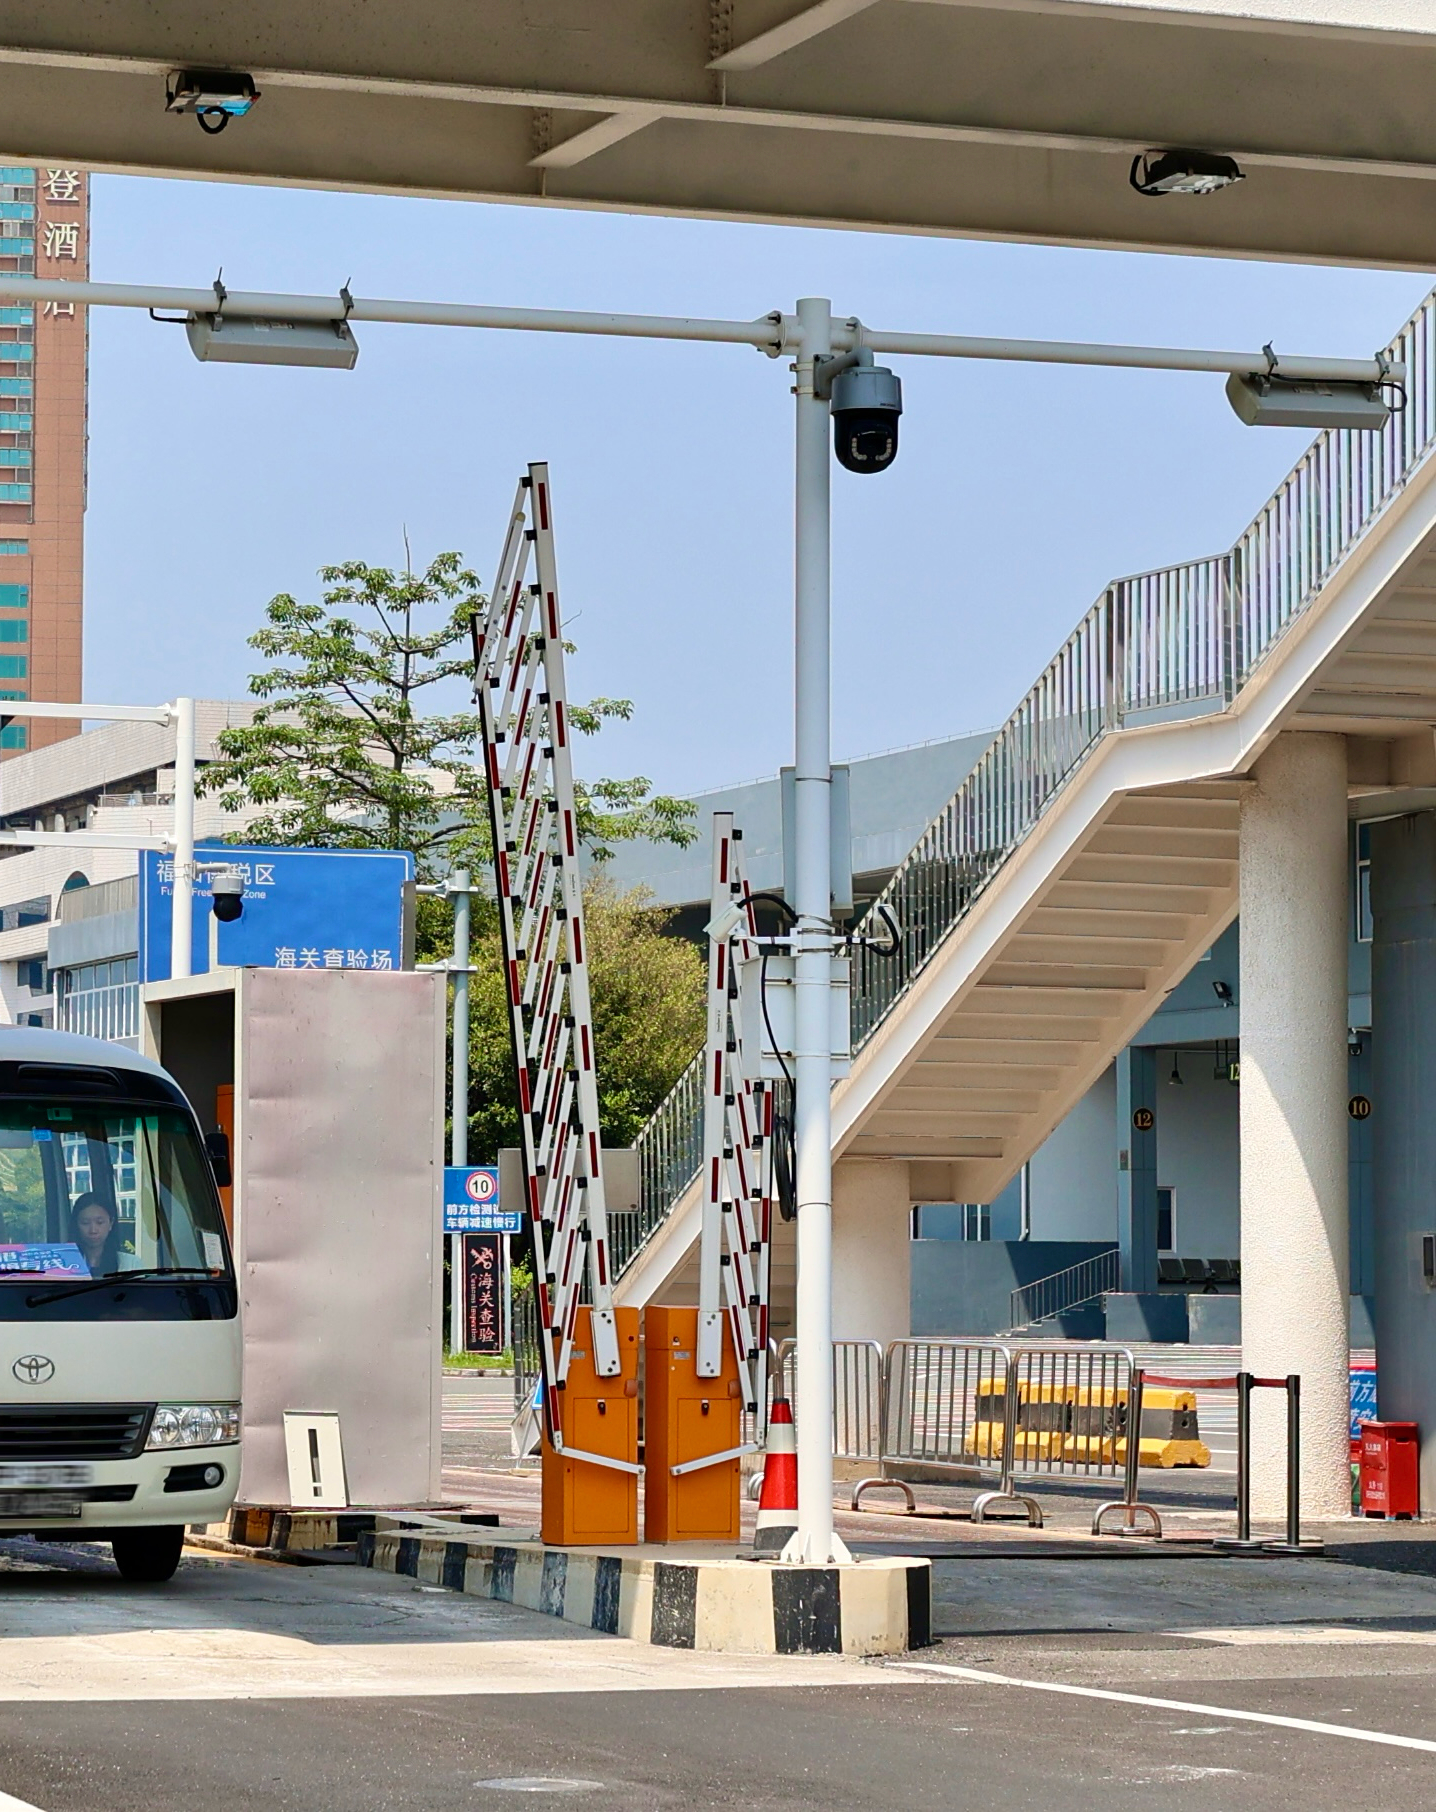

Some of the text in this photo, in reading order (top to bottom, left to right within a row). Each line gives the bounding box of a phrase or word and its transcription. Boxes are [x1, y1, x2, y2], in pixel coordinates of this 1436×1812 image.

[157, 859, 275, 886] 福税区
[192, 887, 213, 897] Free
[242, 889, 266, 899] Zone
[275, 947, 392, 971] 海关查验场
[1351, 1101, 1369, 1115] 10
[1136, 1113, 1152, 1127] 12
[472, 1180, 489, 1194] 10
[446, 1204, 515, 1216] 前方检测设
[470, 1273, 478, 1304] Customs
[478, 1272, 496, 1343] 海关查验
